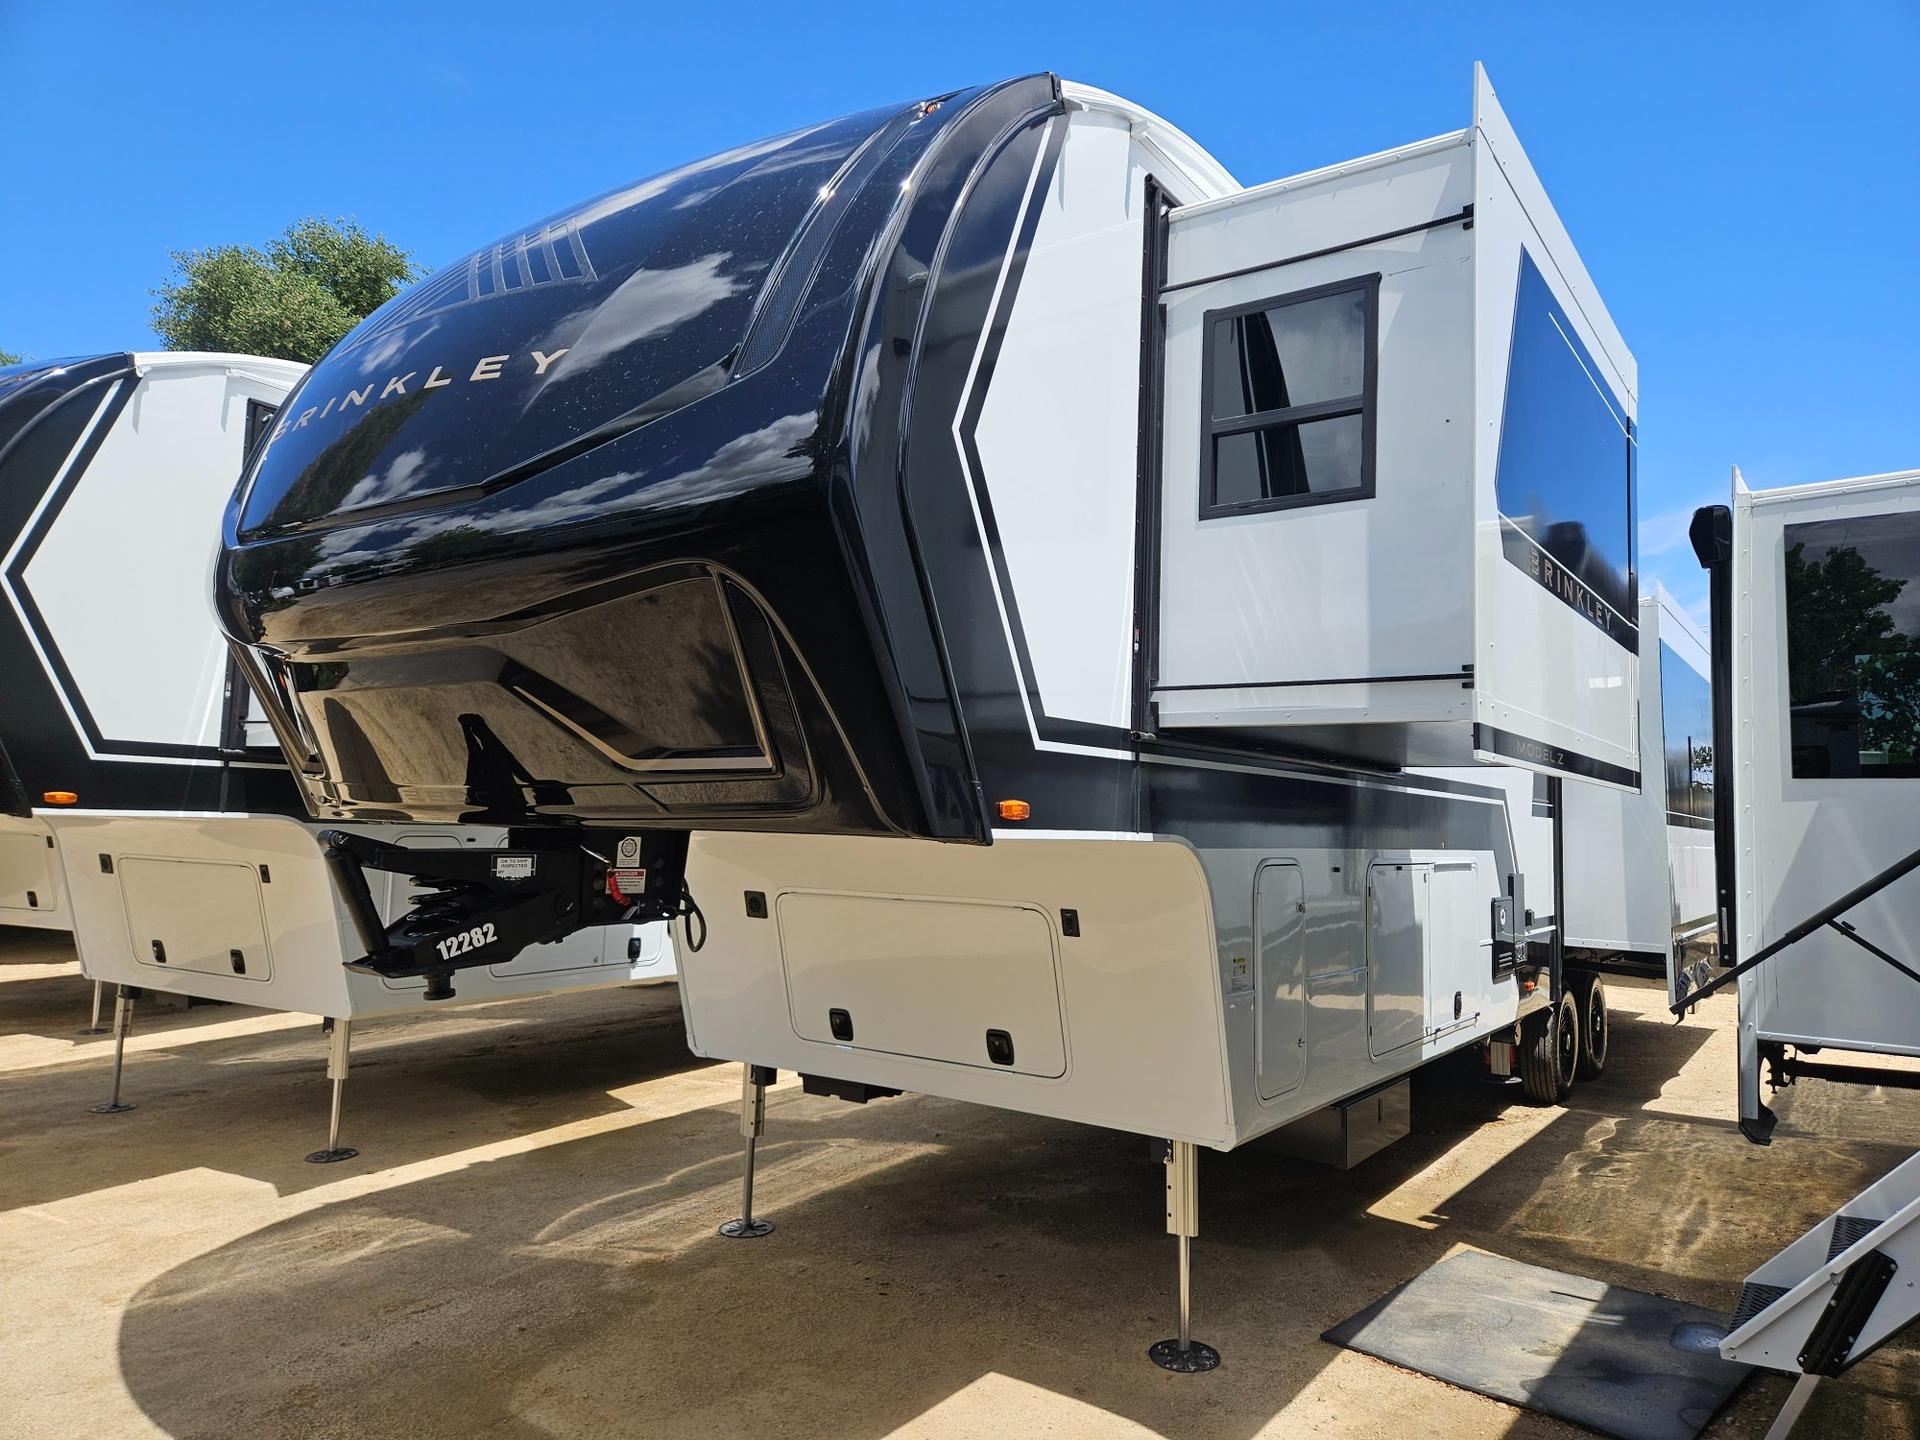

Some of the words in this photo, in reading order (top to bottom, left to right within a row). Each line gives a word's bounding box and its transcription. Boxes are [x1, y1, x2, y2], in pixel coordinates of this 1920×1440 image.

[270, 348, 570, 443] BRINKLEY
[1529, 546, 1612, 630] BRINKLEY
[1516, 740, 1556, 763] MODEL
[1557, 752, 1564, 765] Z
[436, 922, 498, 961] 12282
